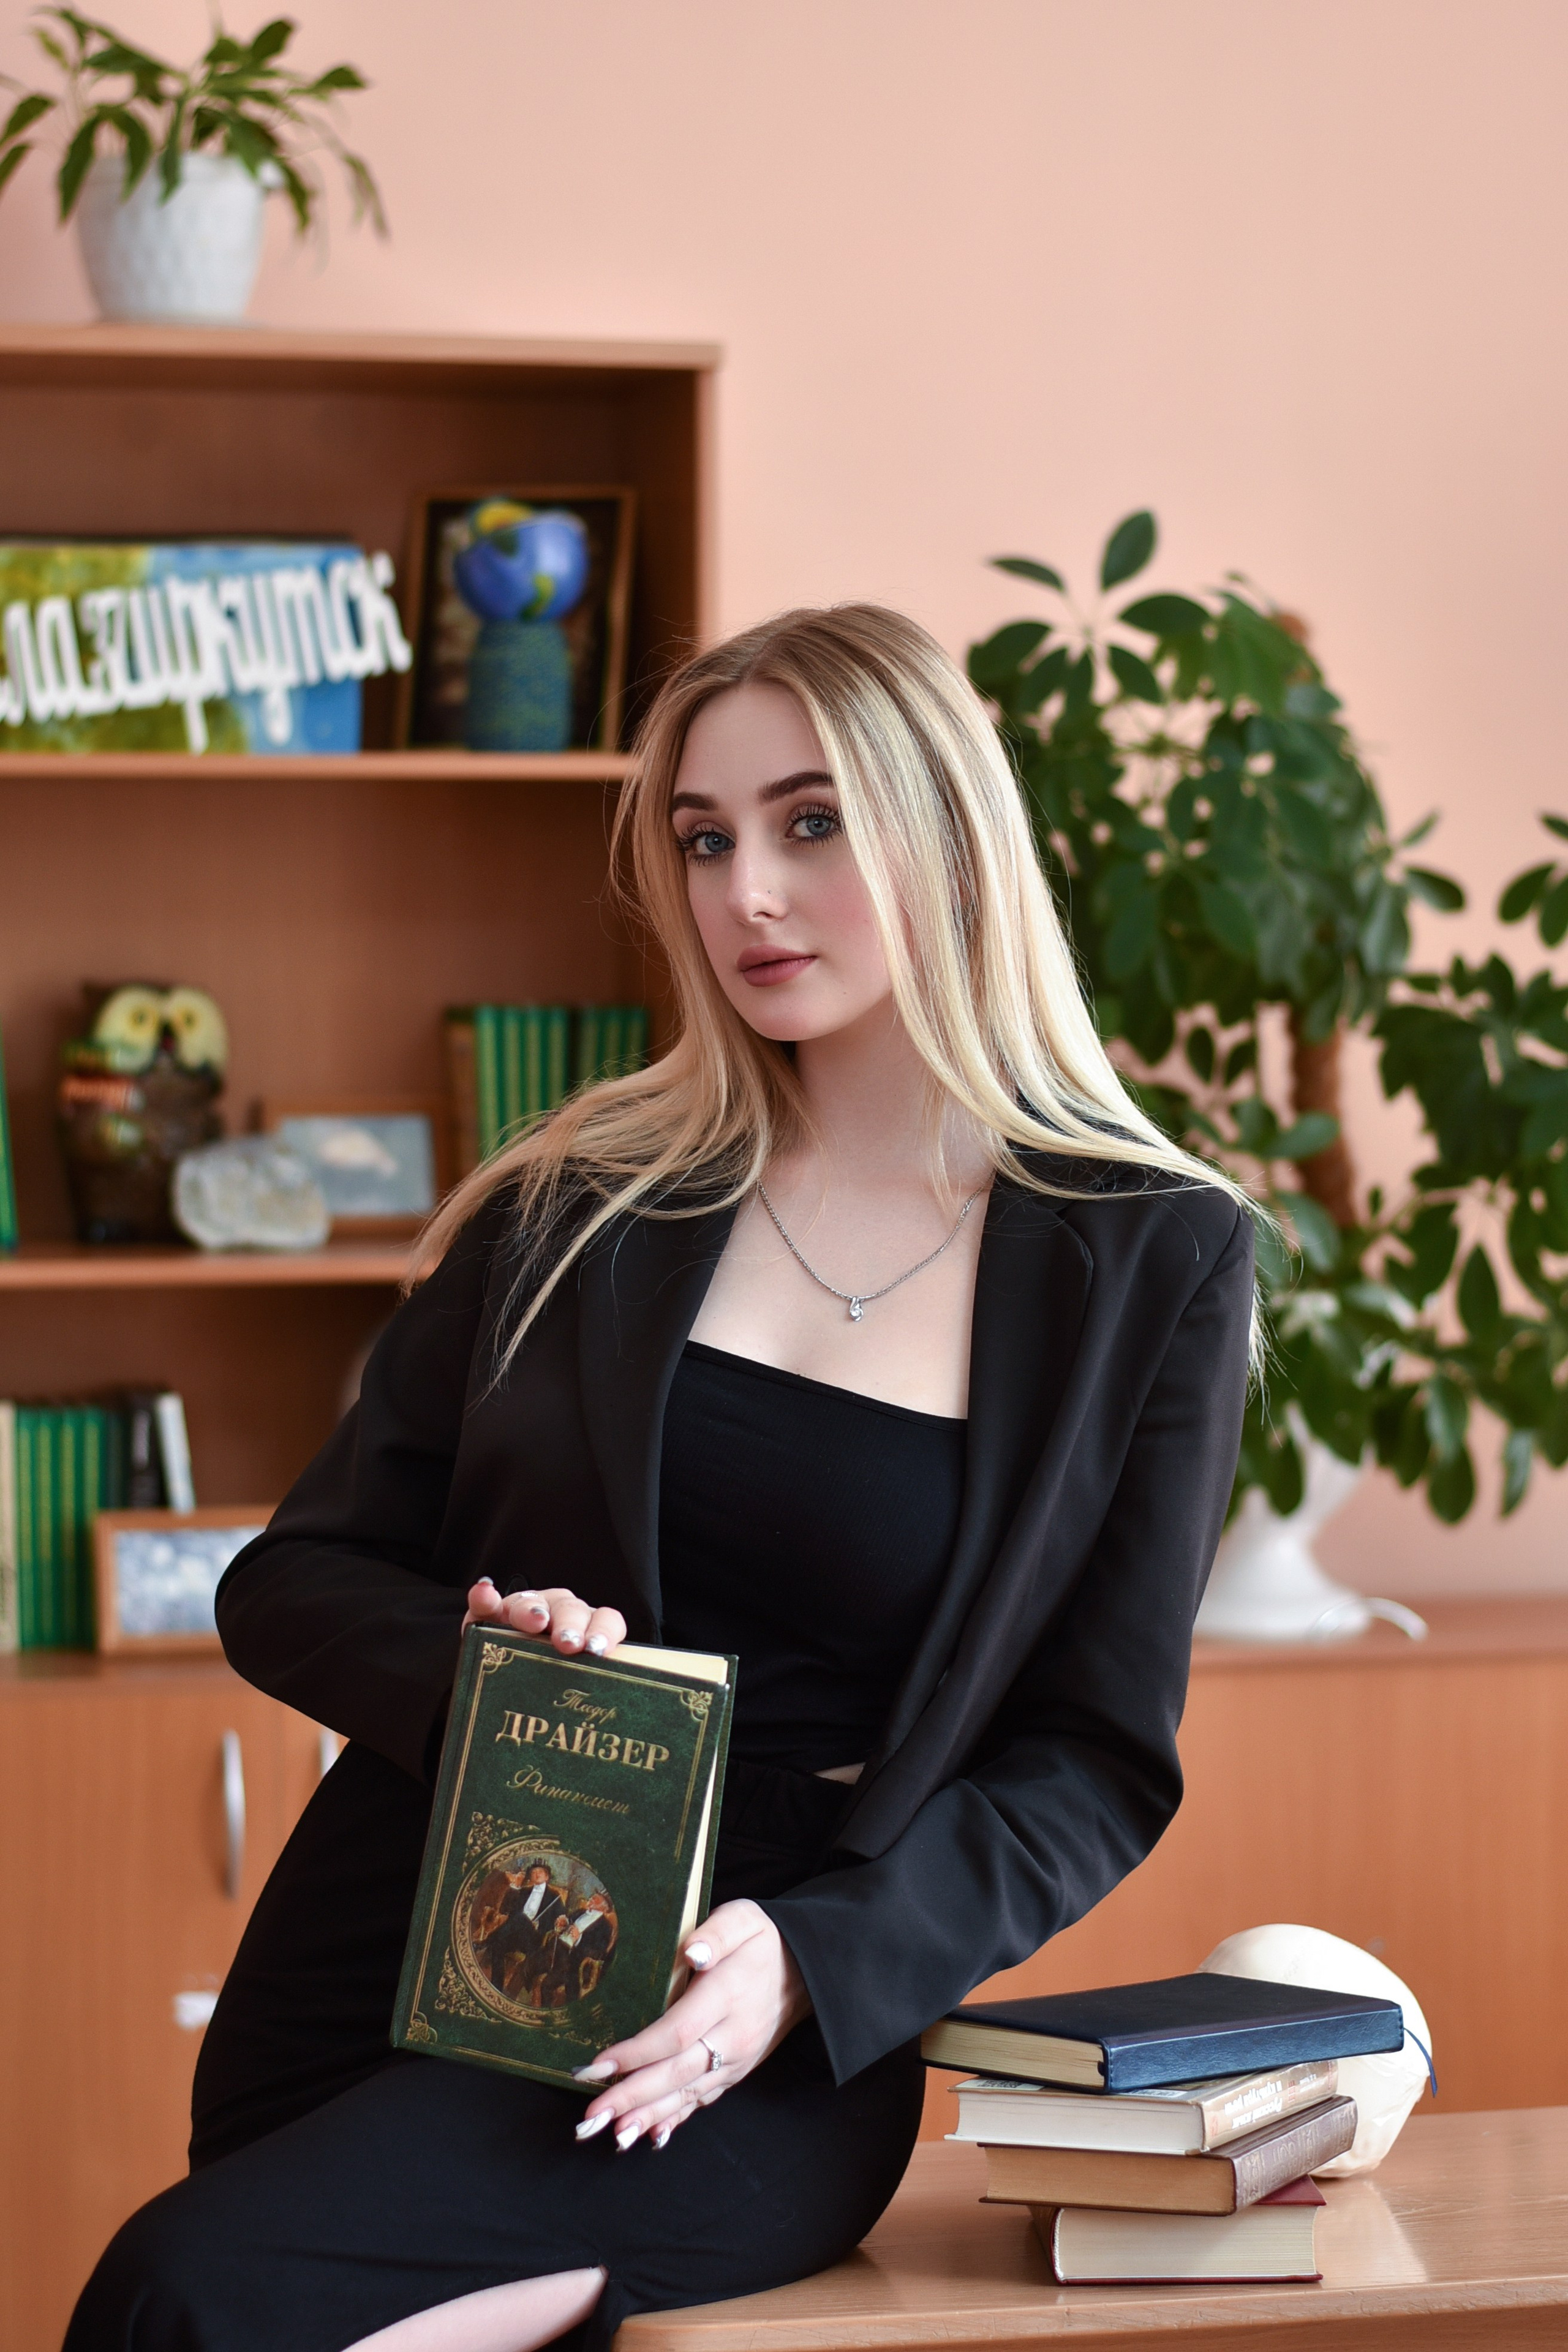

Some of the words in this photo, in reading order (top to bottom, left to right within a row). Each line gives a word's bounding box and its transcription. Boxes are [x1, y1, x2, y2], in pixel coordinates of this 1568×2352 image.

[554, 1688, 617, 1725] Теодор
[495, 1709, 670, 1771] ДРАЙЗЕР
[506, 1764, 630, 1814] Финансист
[1243, 2081, 1276, 2107] культура
[1275, 2080, 1283, 2092] и
[1224, 2094, 1243, 2116] речи
[1253, 2096, 1283, 2123] Русский
[1232, 2111, 1253, 2129] язык
